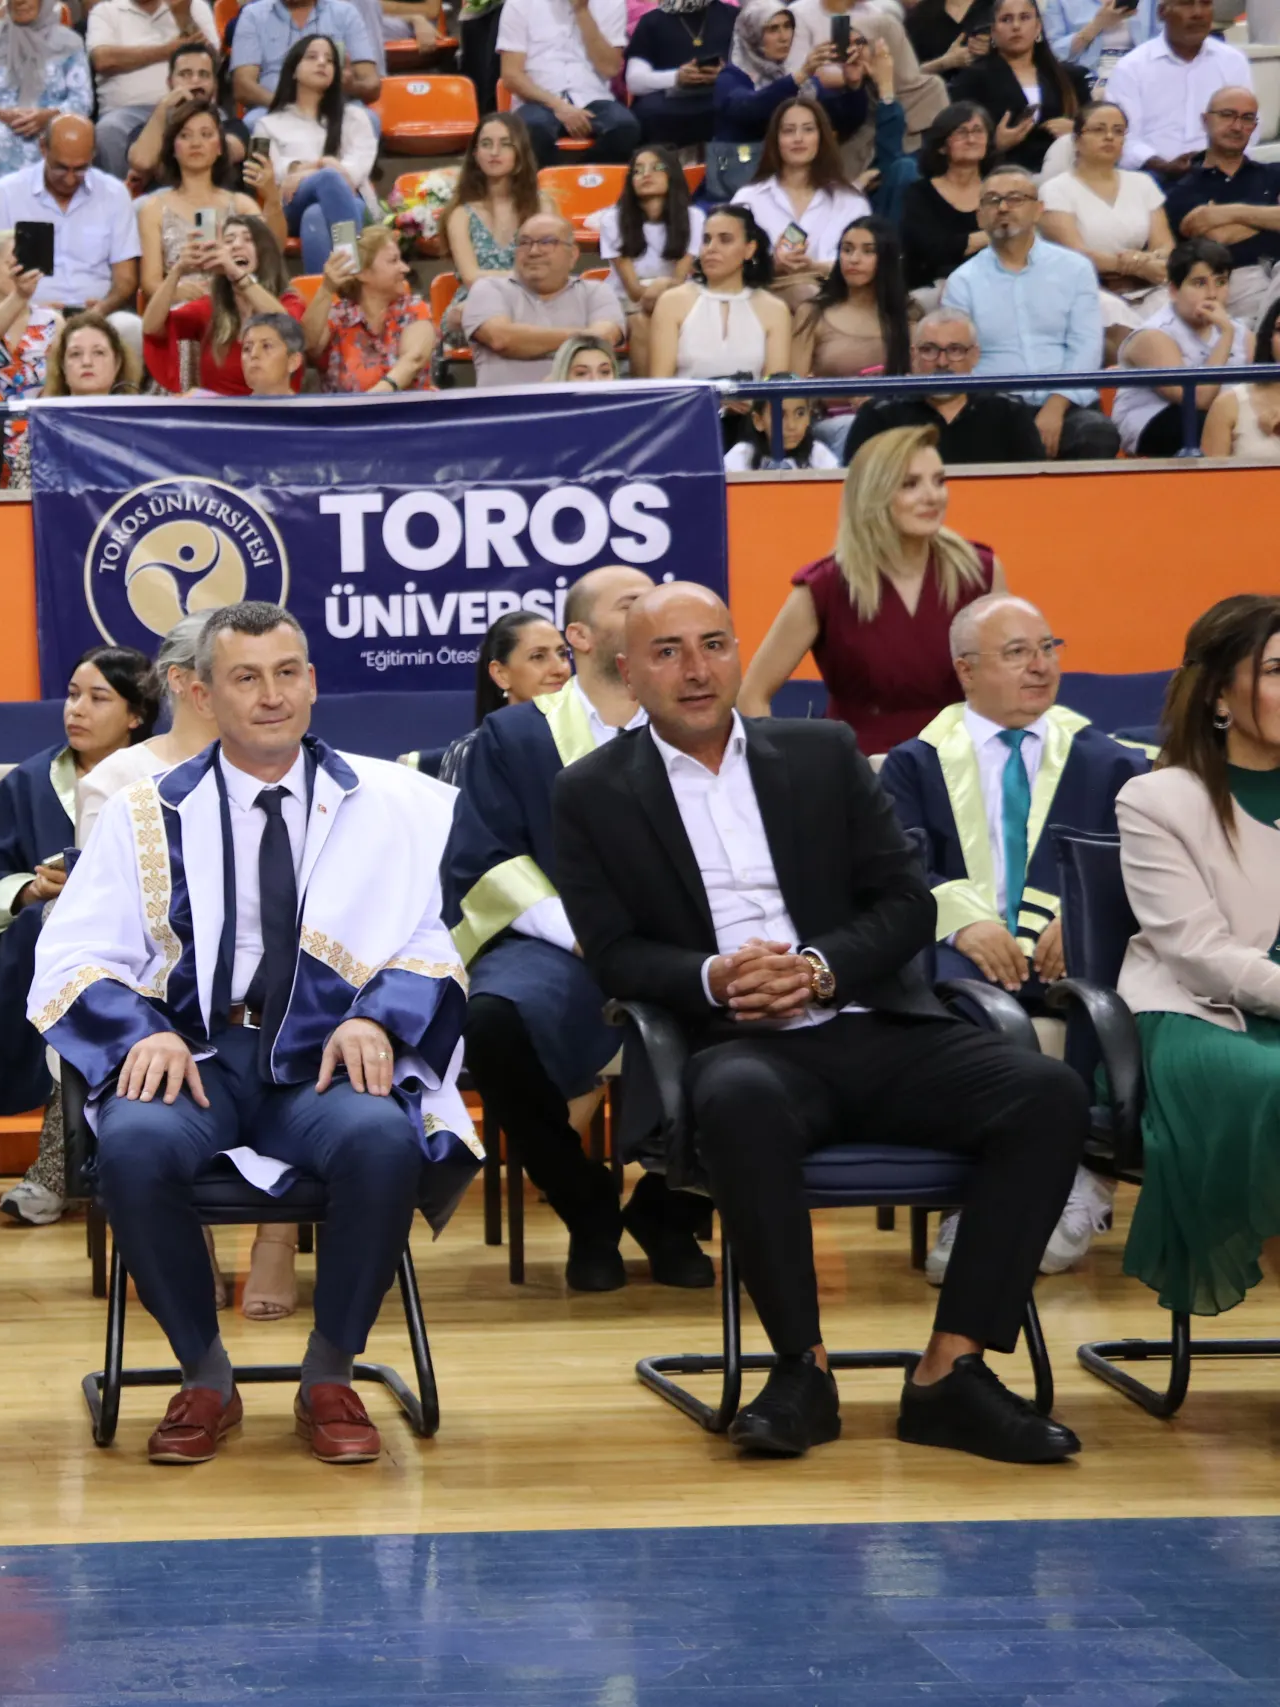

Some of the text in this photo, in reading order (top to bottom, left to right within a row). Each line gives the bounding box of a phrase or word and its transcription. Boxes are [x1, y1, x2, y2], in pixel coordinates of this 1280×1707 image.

[99, 490, 274, 574] TOROS ÜNİVERSİTESİ
[320, 483, 671, 573] TOROS
[324, 572, 674, 639] ÜNİVERSİ
